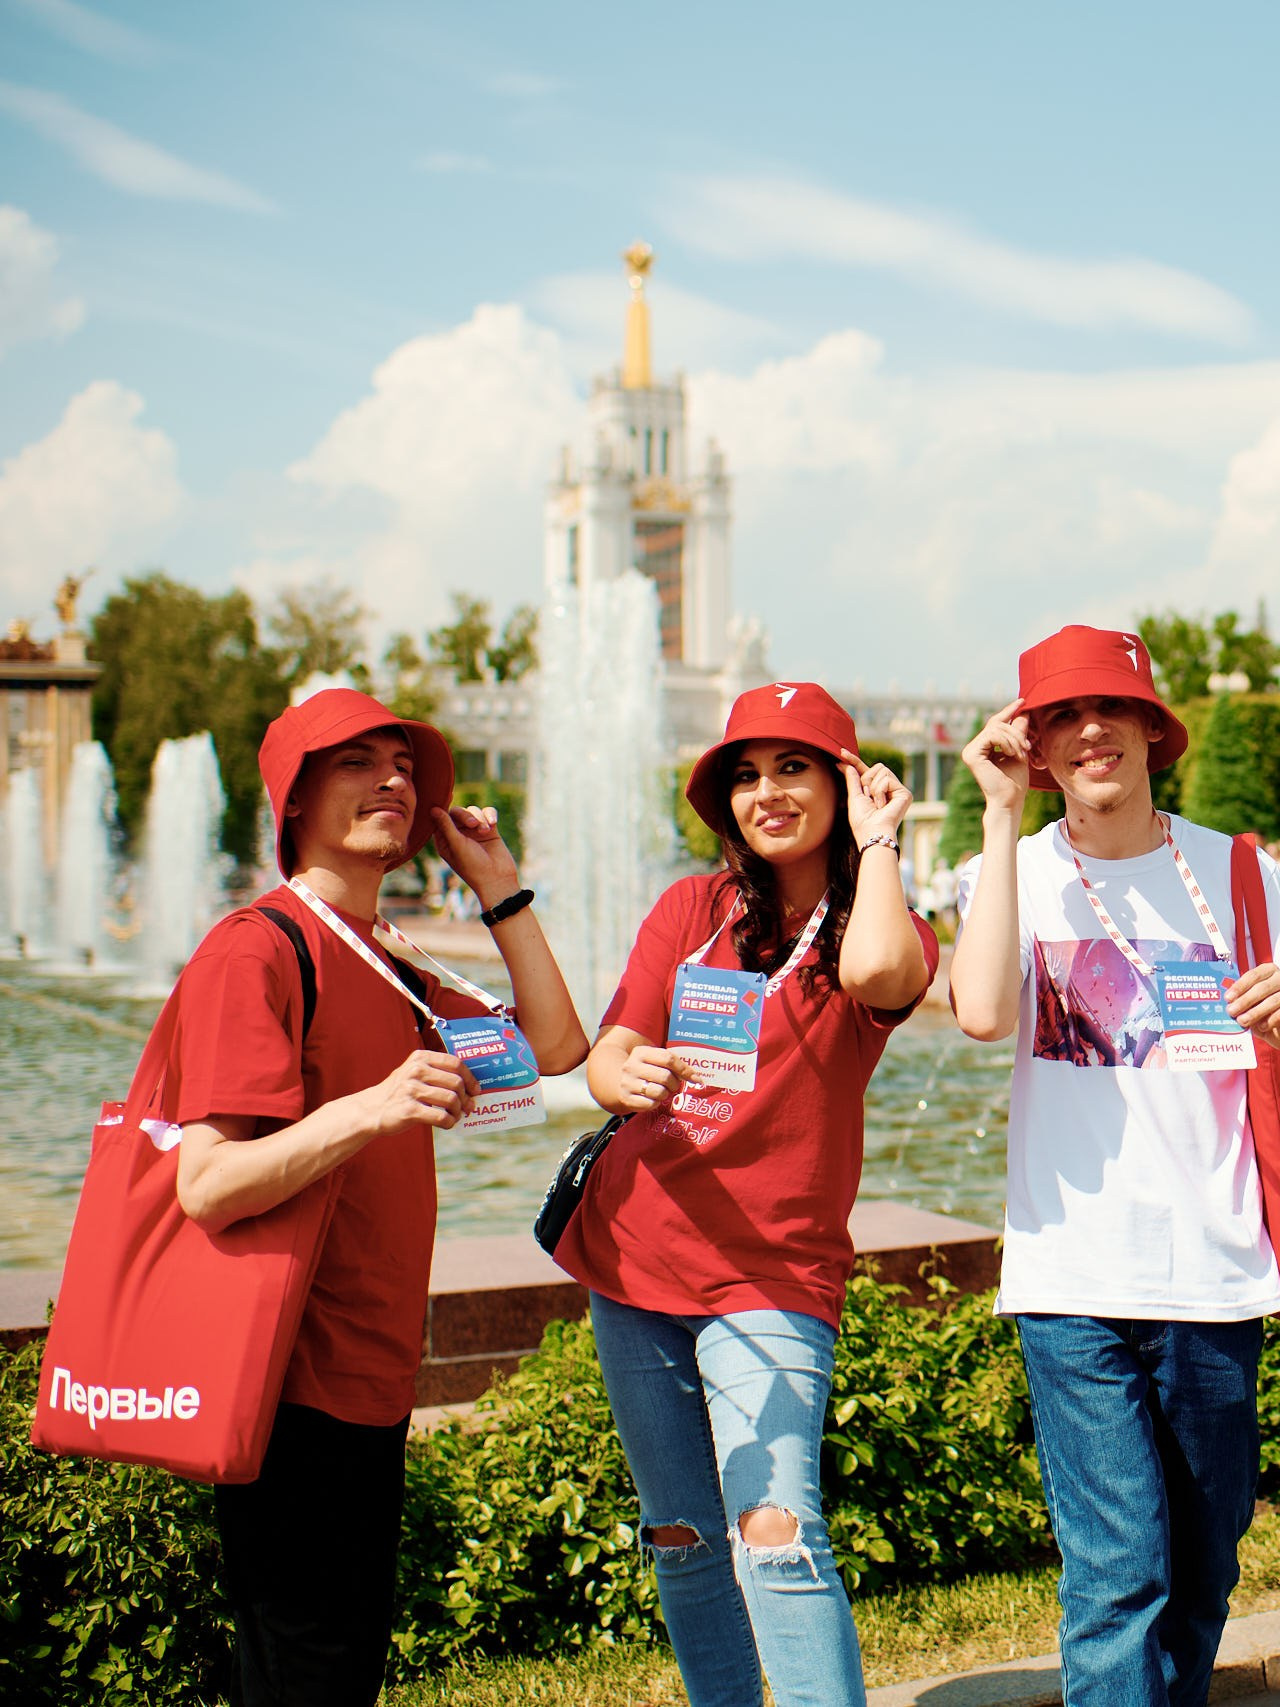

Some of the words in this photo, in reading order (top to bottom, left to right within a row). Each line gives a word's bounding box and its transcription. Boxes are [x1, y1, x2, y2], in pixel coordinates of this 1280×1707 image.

[683, 982, 739, 994] ФЕСТИВАЛЬ
[682, 989, 738, 1002] ДВИЖЕНИЯ
[1166, 991, 1219, 999] ПЕРВЫХ
[681, 999, 737, 1014] ПЕРВЫХ
[449, 1029, 497, 1041] ФЕСТИВАЛЬ
[454, 1035, 501, 1049] ДВИЖЕНИЯ
[457, 1042, 506, 1059] ПЕРВЫХ
[1174, 1044, 1244, 1054] УЧАСТНИК
[463, 1116, 507, 1128] PARTICIPANT
[49, 1366, 200, 1431] Первые
